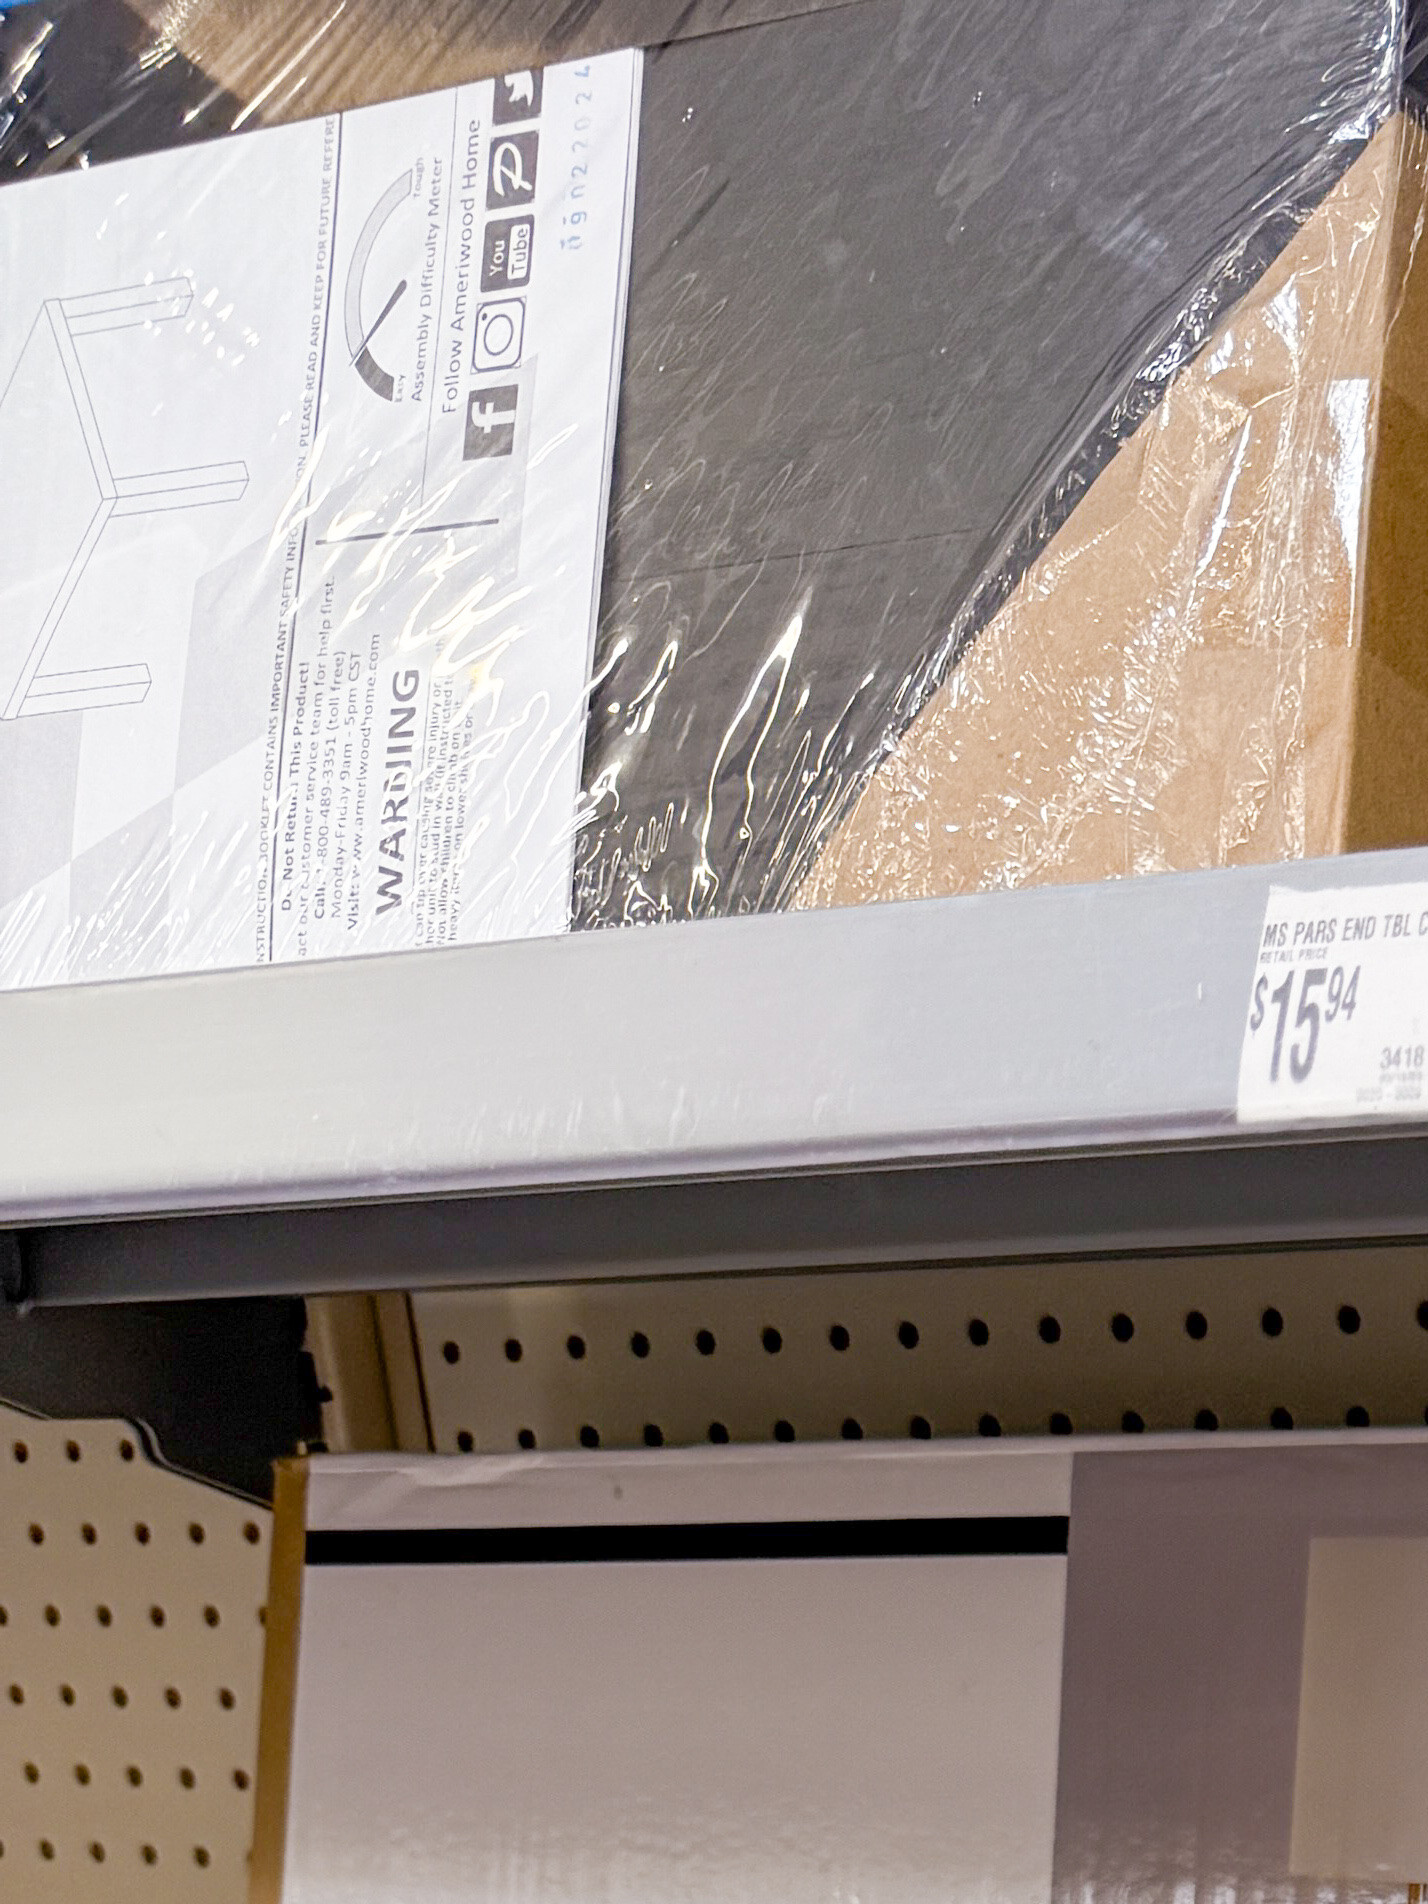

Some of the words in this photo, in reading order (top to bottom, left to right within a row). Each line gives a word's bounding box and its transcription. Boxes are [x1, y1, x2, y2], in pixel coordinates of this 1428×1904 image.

[427, 157, 443, 217] Meter
[461, 119, 481, 190] Home
[419, 223, 440, 308] Difficulty
[450, 197, 475, 332] Ameriwood
[488, 239, 506, 277] You
[511, 228, 528, 275] Tube
[411, 313, 433, 402] Assembly
[441, 339, 463, 414] Follow
[1262, 923, 1290, 949] MS
[1292, 917, 1338, 946] PARS
[1341, 915, 1377, 942] END
[1383, 913, 1411, 938] TBL
